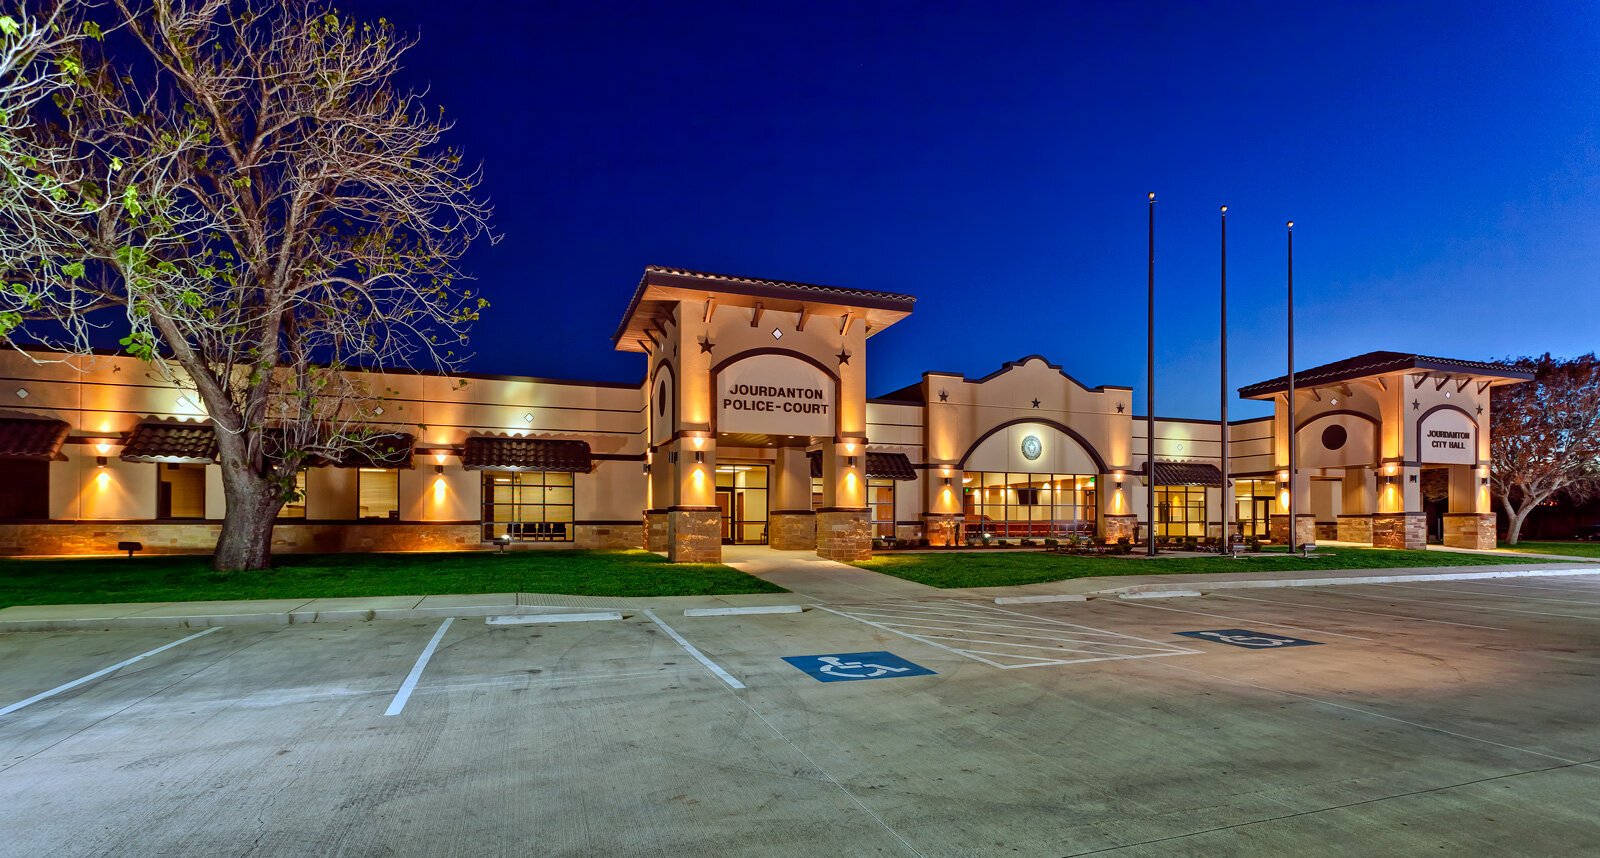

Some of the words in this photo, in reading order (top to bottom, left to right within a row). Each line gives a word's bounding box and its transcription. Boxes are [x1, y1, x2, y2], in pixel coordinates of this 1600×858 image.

[730, 384, 823, 399] JOURDANTON
[723, 399, 829, 414] POLICE-COURT
[1427, 430, 1470, 439] JOURDANTON
[1431, 440, 1447, 448] CITY
[1449, 441, 1466, 449] HALL
